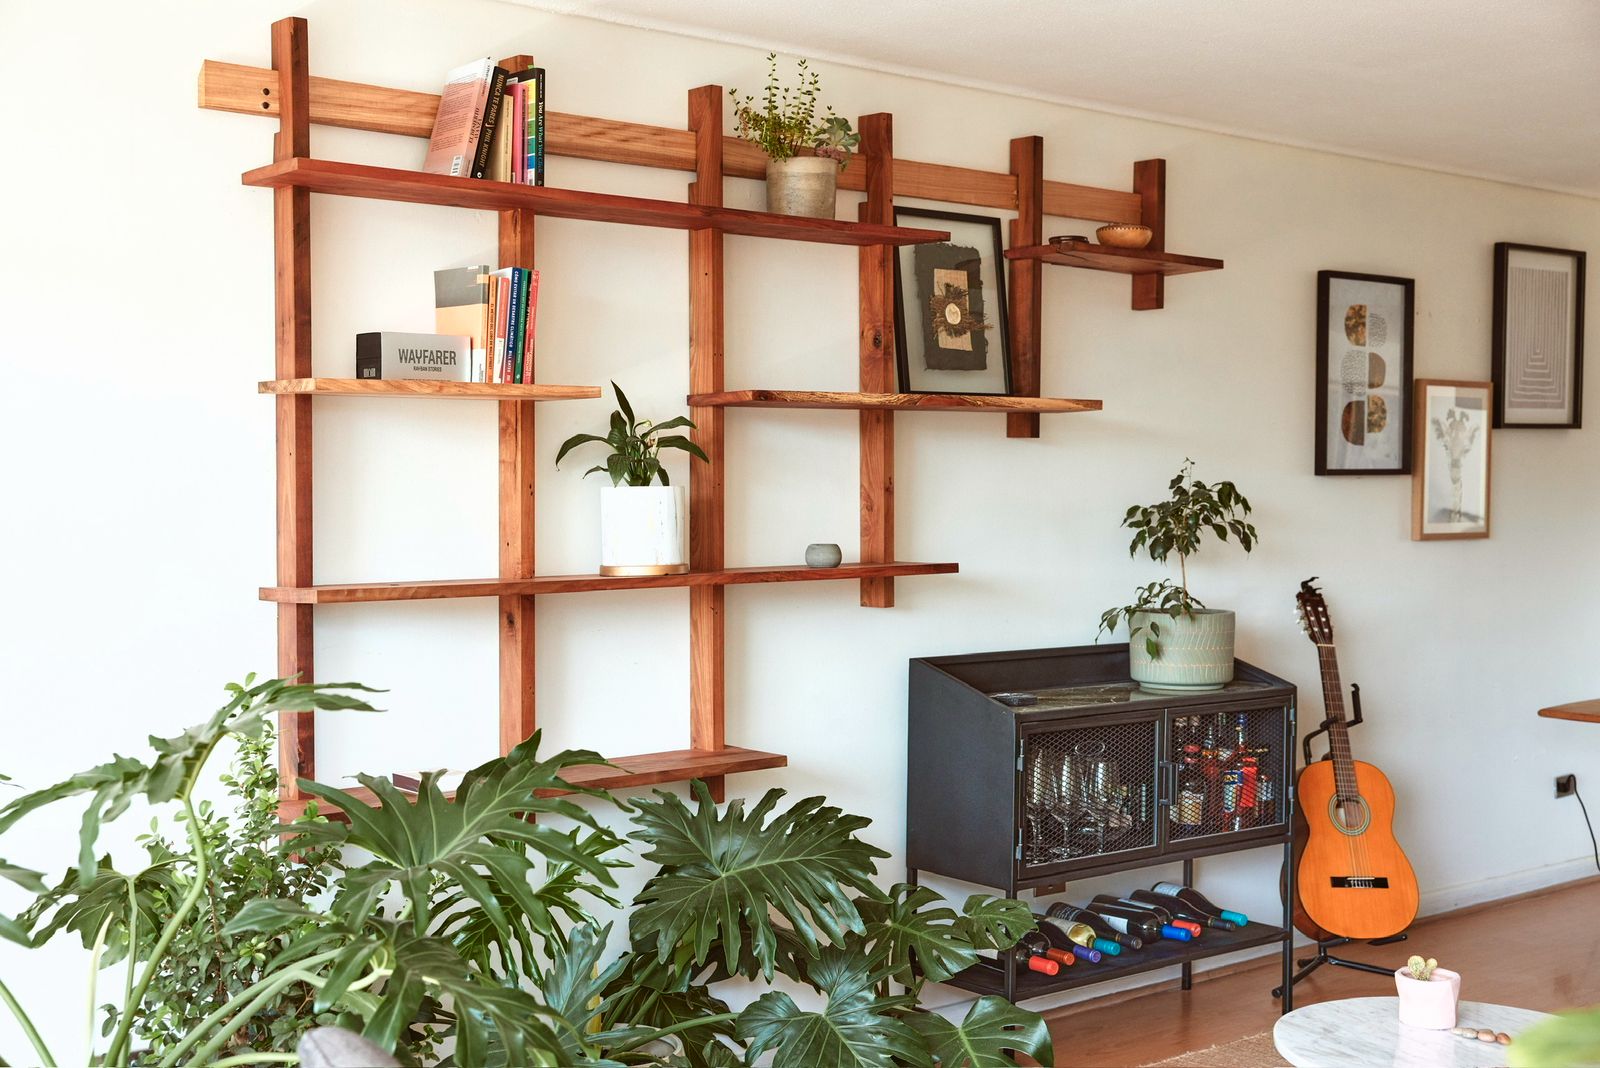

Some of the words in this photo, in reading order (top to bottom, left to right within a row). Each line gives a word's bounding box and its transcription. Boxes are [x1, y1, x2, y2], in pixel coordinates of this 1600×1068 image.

[494, 74, 504, 95] NUNCA
[488, 104, 498, 124] PARES
[484, 128, 492, 144] PHIL
[479, 144, 489, 167] KNIGHT
[398, 348, 456, 365] WAYFARER
